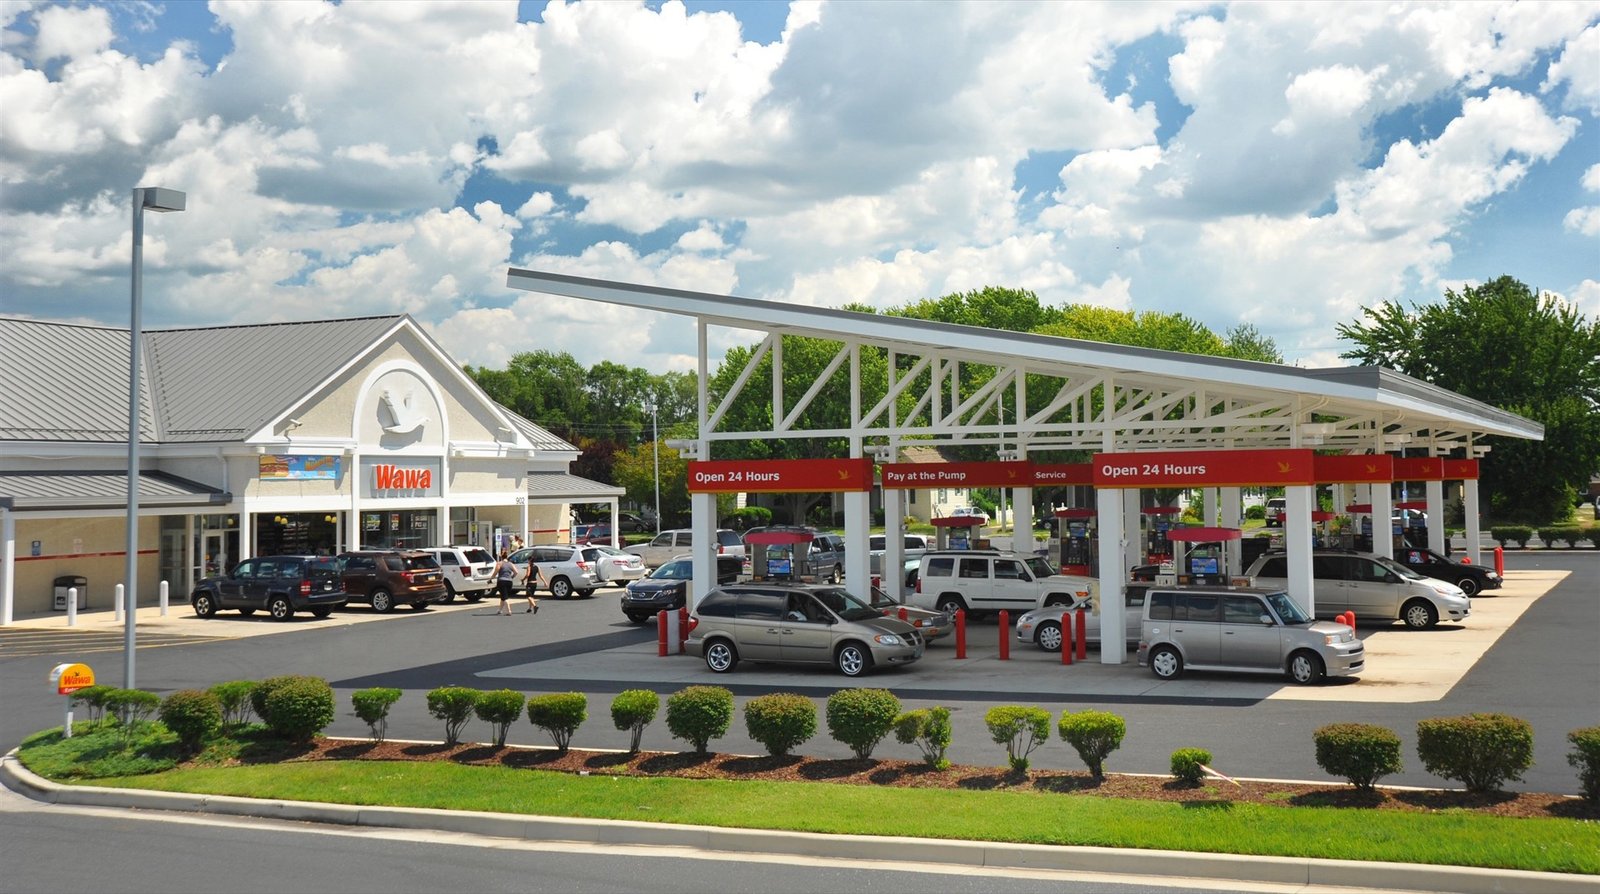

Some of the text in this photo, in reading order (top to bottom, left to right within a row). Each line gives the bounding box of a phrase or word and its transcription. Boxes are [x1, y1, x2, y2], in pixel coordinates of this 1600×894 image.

[376, 464, 432, 489] Wawa
[695, 471, 780, 485] Open 24 Hours
[887, 471, 966, 481] Pay at the Pump
[1102, 464, 1206, 478] Open 24 Hours
[65, 675, 90, 685] Wawa
